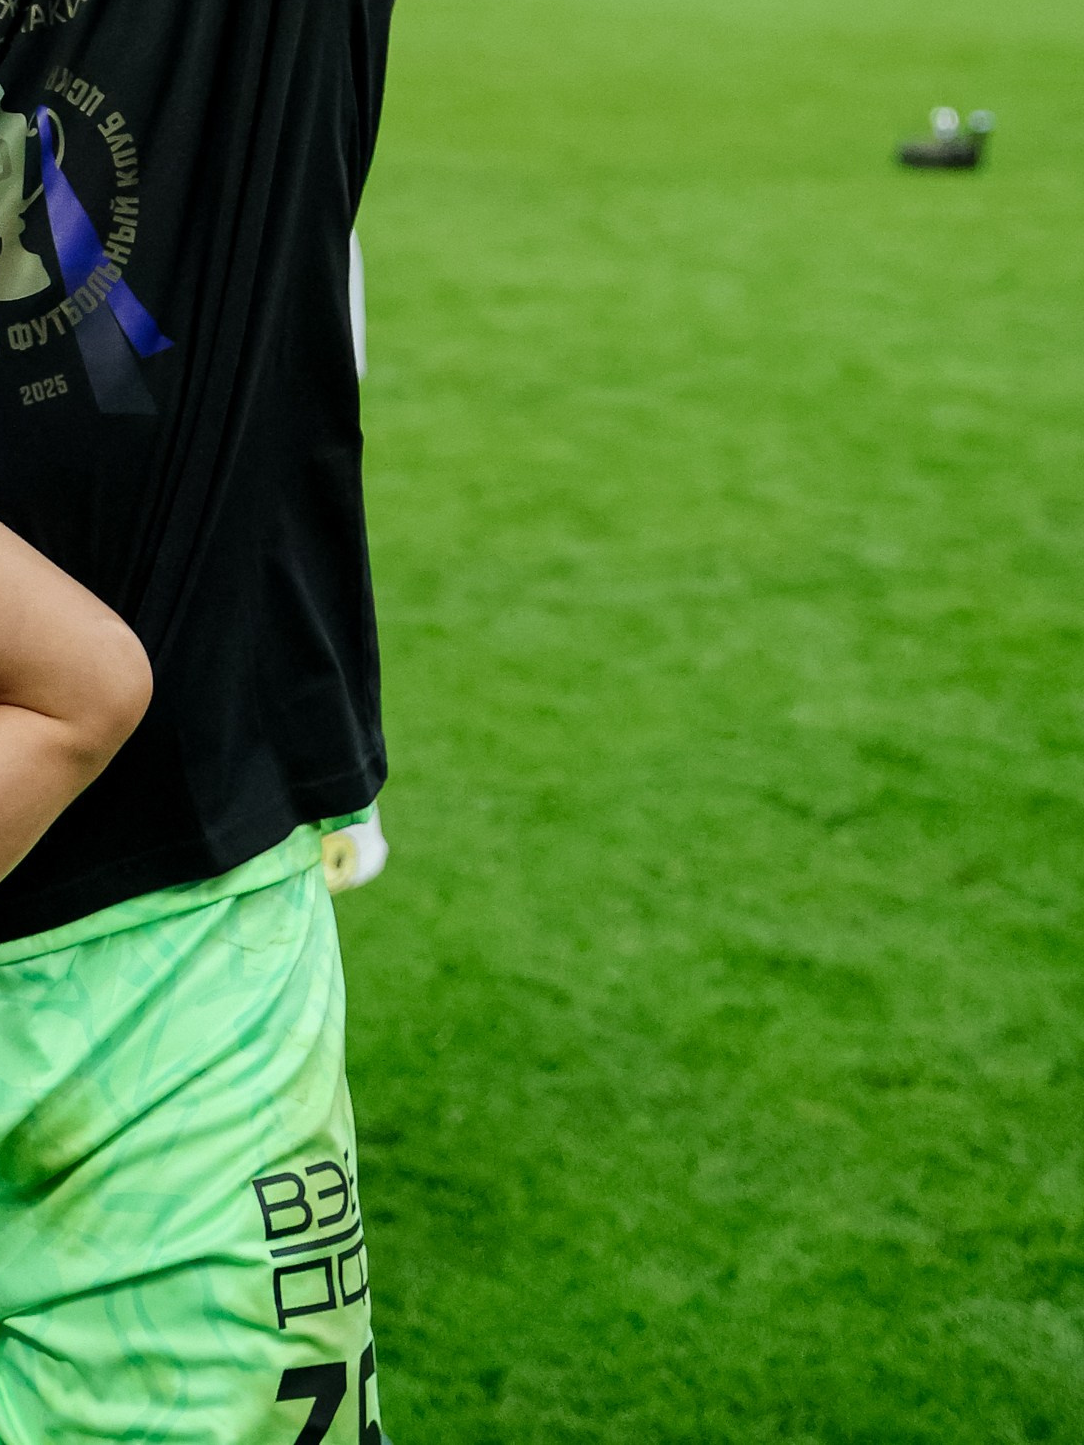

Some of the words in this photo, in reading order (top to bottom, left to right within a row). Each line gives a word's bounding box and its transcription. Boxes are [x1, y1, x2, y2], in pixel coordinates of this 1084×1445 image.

[7, 195, 140, 352] ФУТБОЛЬНЫЙ
[97, 111, 140, 188] КЛУБ
[19, 373, 68, 406] 2025
[252, 1146, 357, 1242] ВЭ
